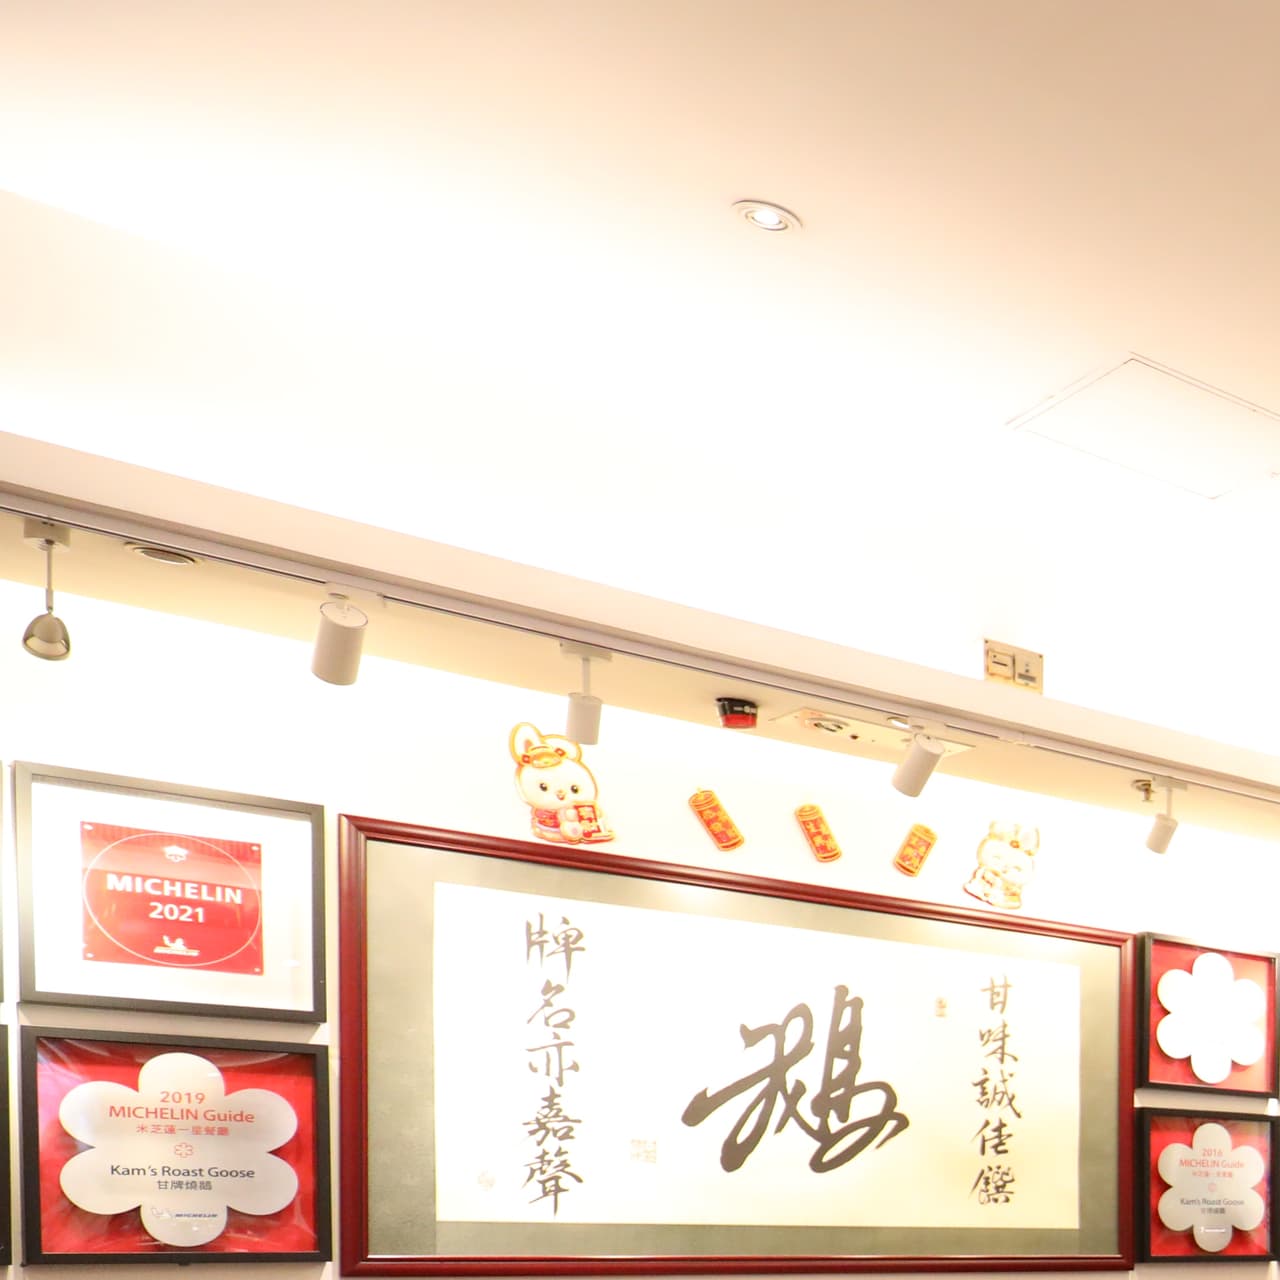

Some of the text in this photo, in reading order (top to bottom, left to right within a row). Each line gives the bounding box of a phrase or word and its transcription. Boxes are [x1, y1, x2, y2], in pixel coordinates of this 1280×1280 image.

[106, 873, 242, 905] MICHELIN
[148, 901, 204, 923] 2021
[521, 912, 586, 1216] 牌名亦嘉聲
[160, 1091, 206, 1104] 2019
[109, 1105, 255, 1123] MICHELIN Guide
[111, 1164, 255, 1179] Kam's Roast Goose
[1179, 1159, 1219, 1168] MICHELIN
